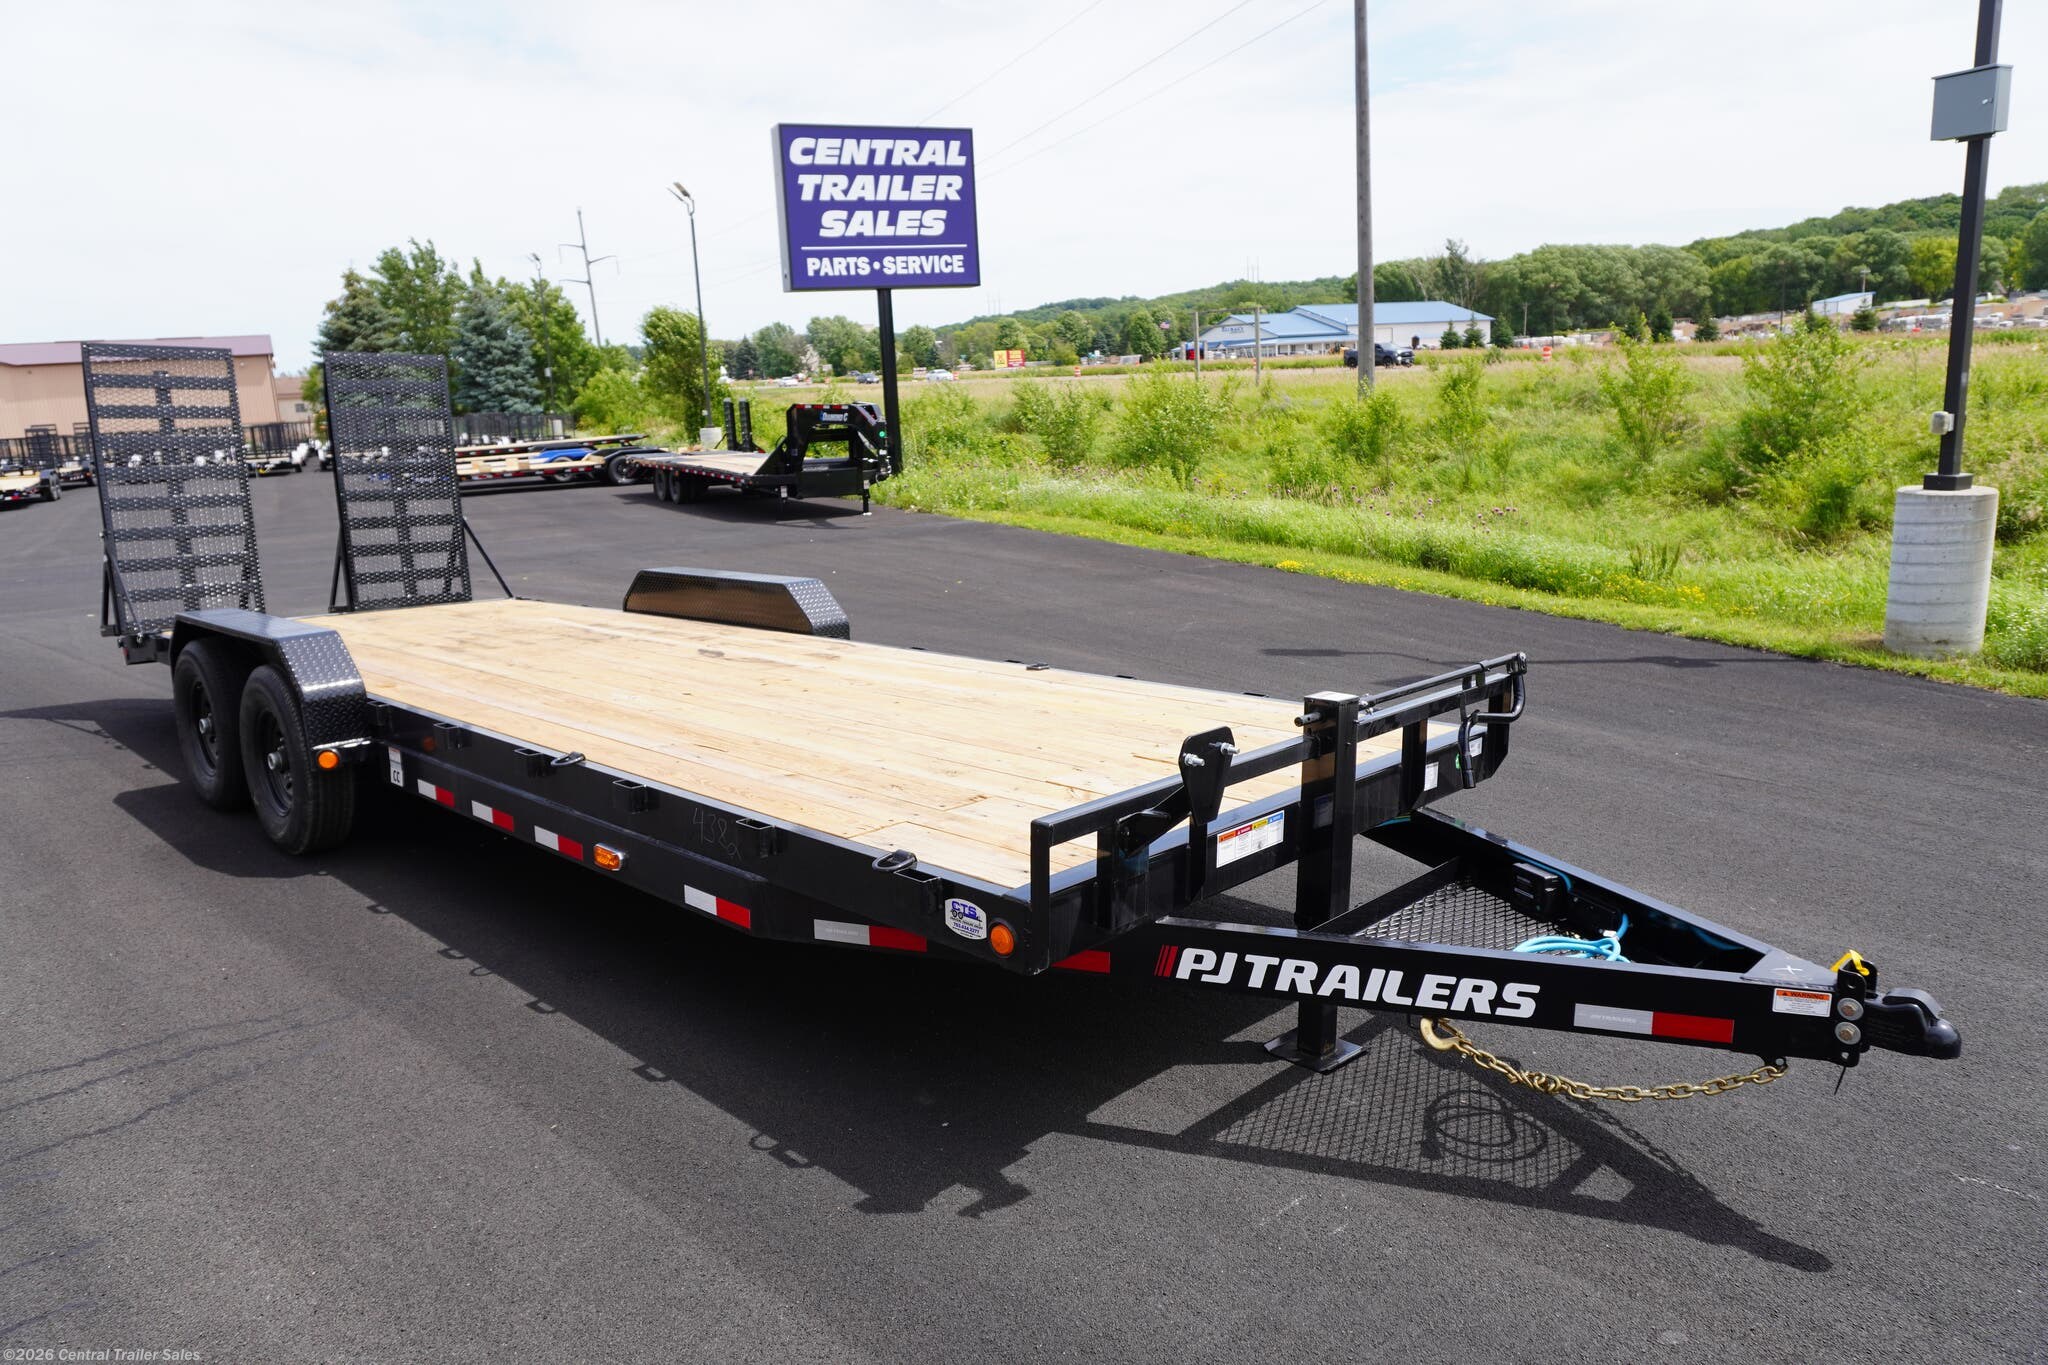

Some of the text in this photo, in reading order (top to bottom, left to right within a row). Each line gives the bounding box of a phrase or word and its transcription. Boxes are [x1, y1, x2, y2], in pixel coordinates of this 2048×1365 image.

[789, 137, 967, 166] CENTRAL
[797, 174, 963, 201] TRAILER
[819, 209, 947, 238] SALES
[951, 900, 977, 918] CTS
[1175, 947, 1541, 1019] PJ TRAILERS
